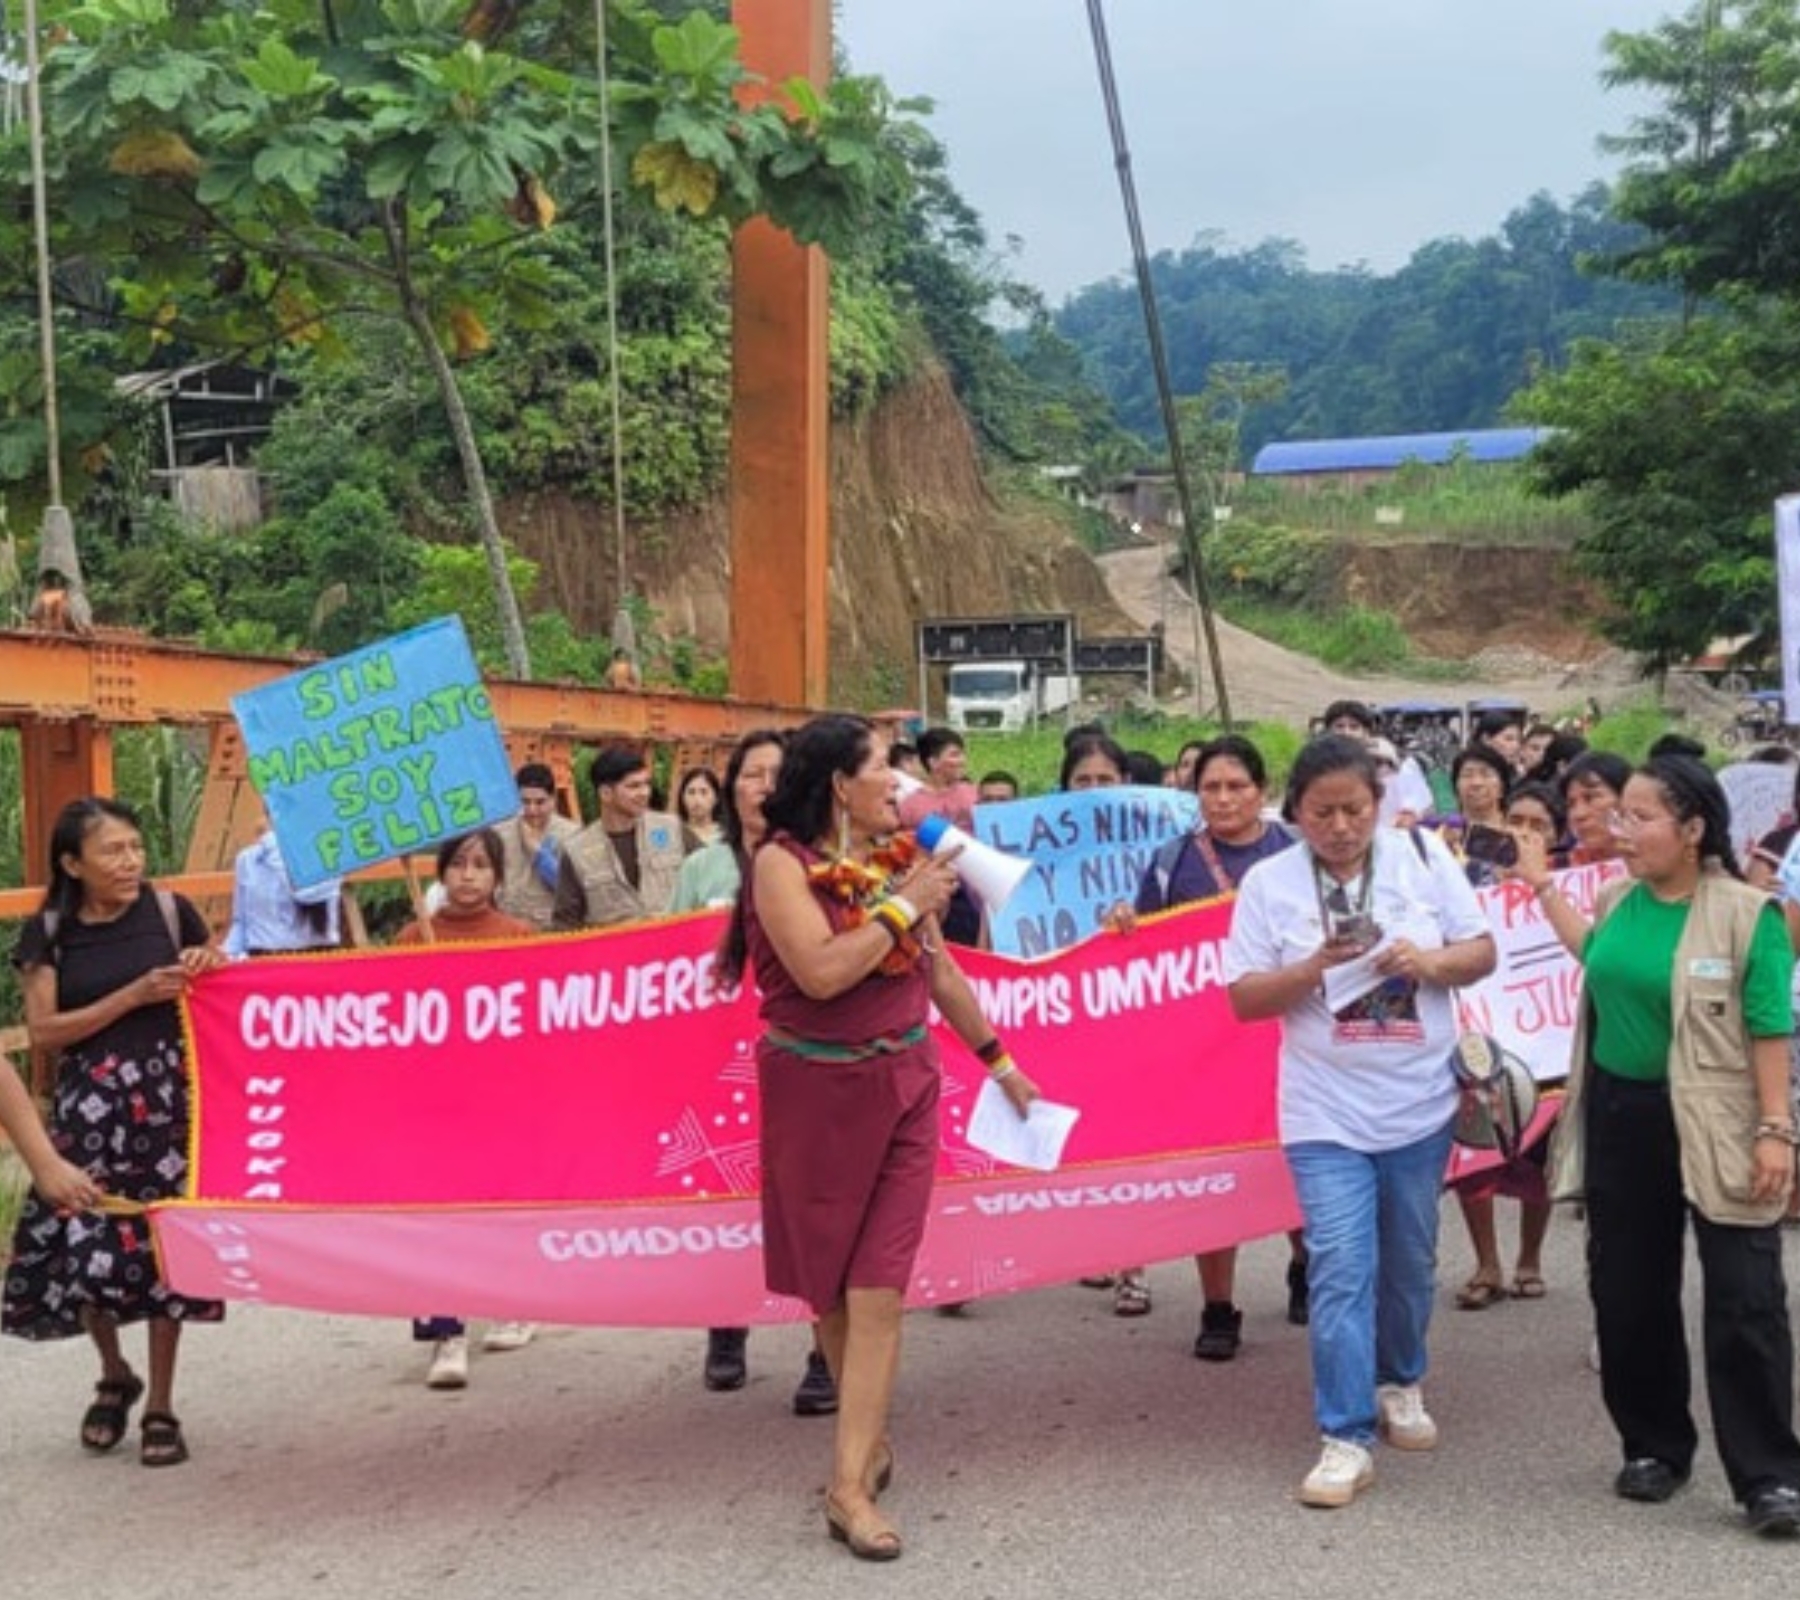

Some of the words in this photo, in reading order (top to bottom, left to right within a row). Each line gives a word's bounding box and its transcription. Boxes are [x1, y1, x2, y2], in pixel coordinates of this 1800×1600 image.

[297, 650, 397, 720] SIN
[249, 682, 493, 794] MALTRATO
[327, 752, 436, 819] SOY
[315, 784, 484, 873] FELIZ
[989, 809, 1080, 853] LAS
[1034, 862, 1056, 905] Y
[240, 988, 450, 1051] CONSEJO
[463, 980, 526, 1042] DE
